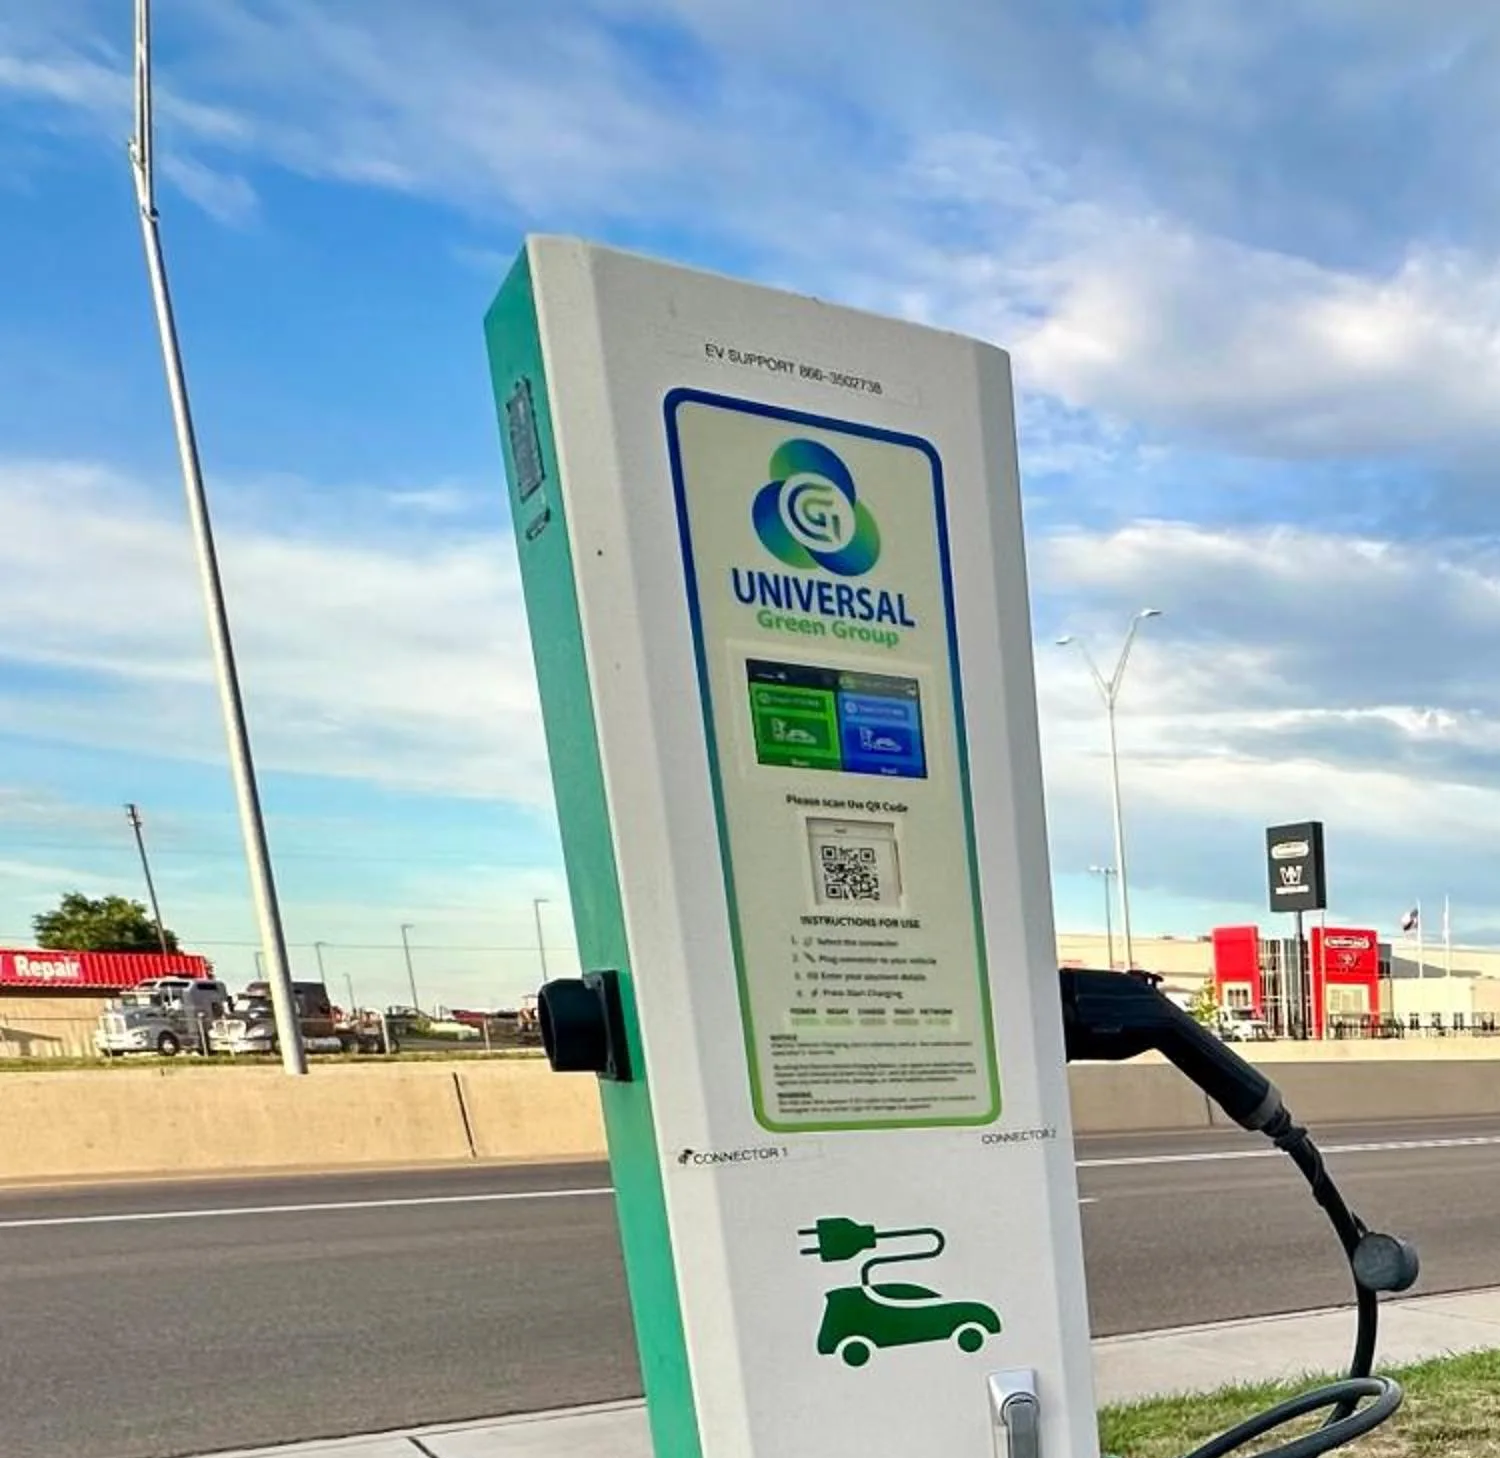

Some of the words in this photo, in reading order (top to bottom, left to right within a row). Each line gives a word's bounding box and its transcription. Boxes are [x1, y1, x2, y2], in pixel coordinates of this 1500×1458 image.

[705, 343, 725, 359] EV
[728, 349, 795, 374] SUPPORT
[732, 567, 915, 628] UNIVERSAL
[757, 608, 825, 637] Green
[831, 620, 900, 650] Group
[13, 954, 81, 980] Repair
[982, 1129, 1049, 1145] CONNECTOR
[693, 1147, 779, 1166] CONNECTOR
